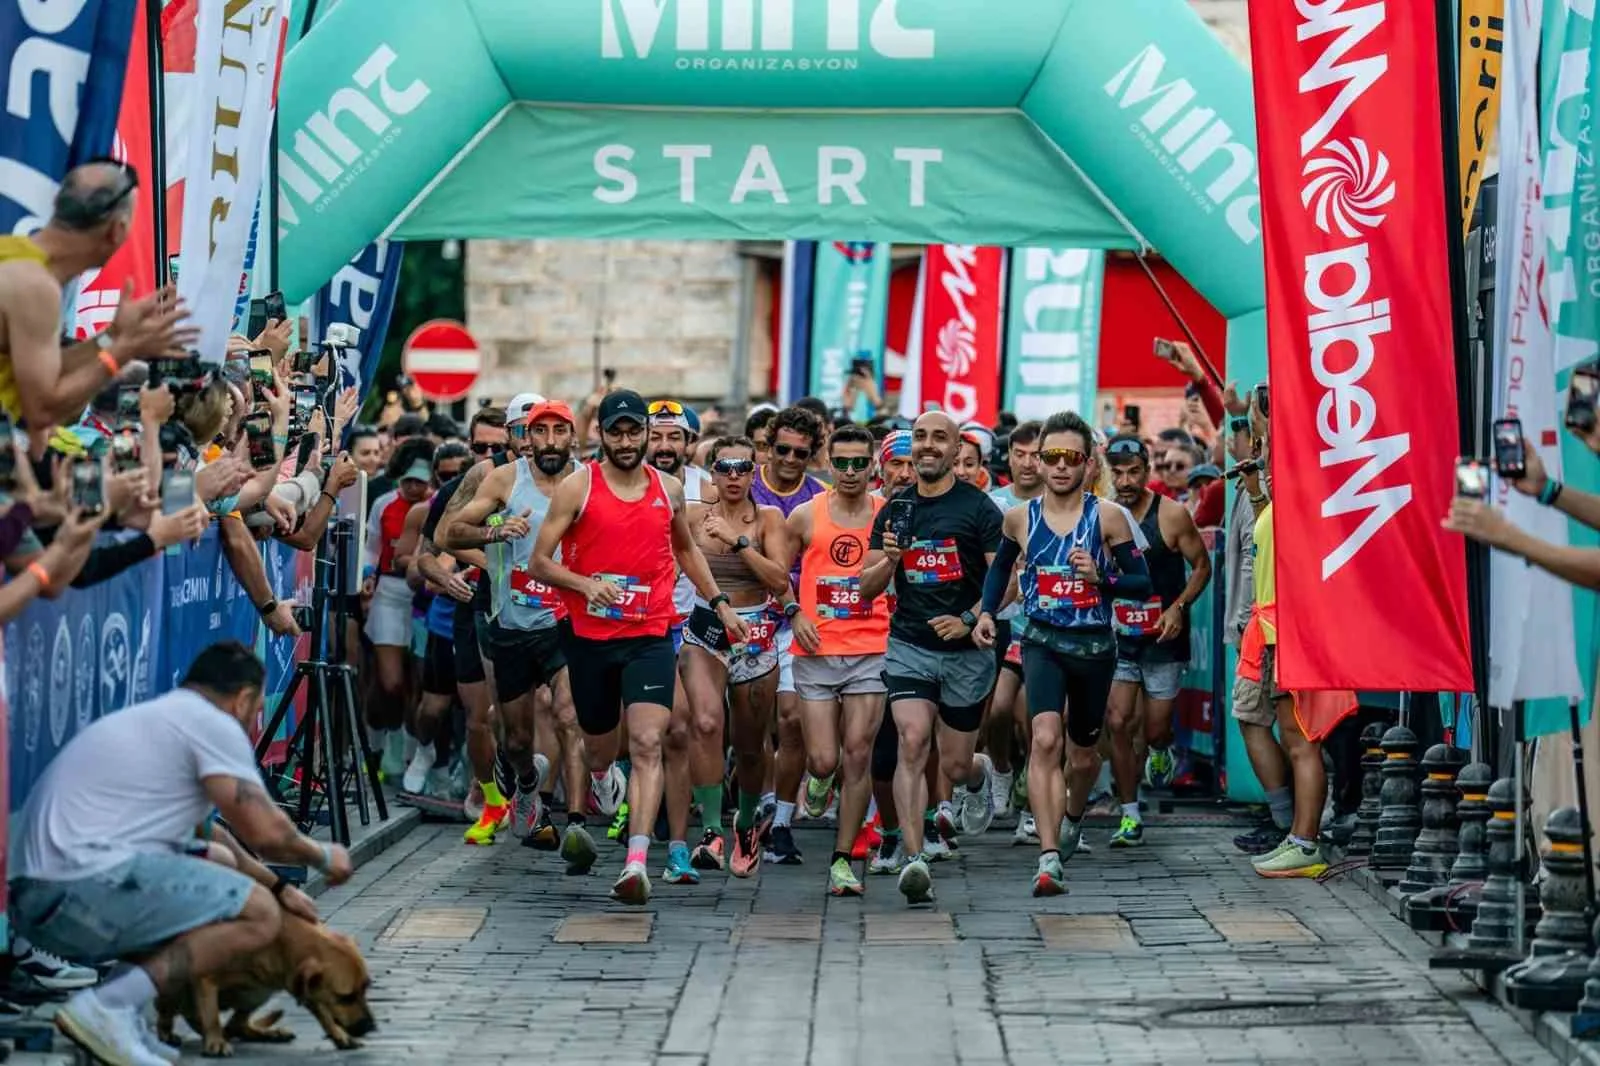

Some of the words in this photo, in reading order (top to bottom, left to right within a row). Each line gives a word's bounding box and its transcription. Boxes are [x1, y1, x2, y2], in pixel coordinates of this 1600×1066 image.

[592, 144, 943, 207] START
[916, 554, 948, 568] 494
[1051, 580, 1085, 596] 475
[830, 591, 860, 604] 326
[1126, 611, 1149, 624] 231
